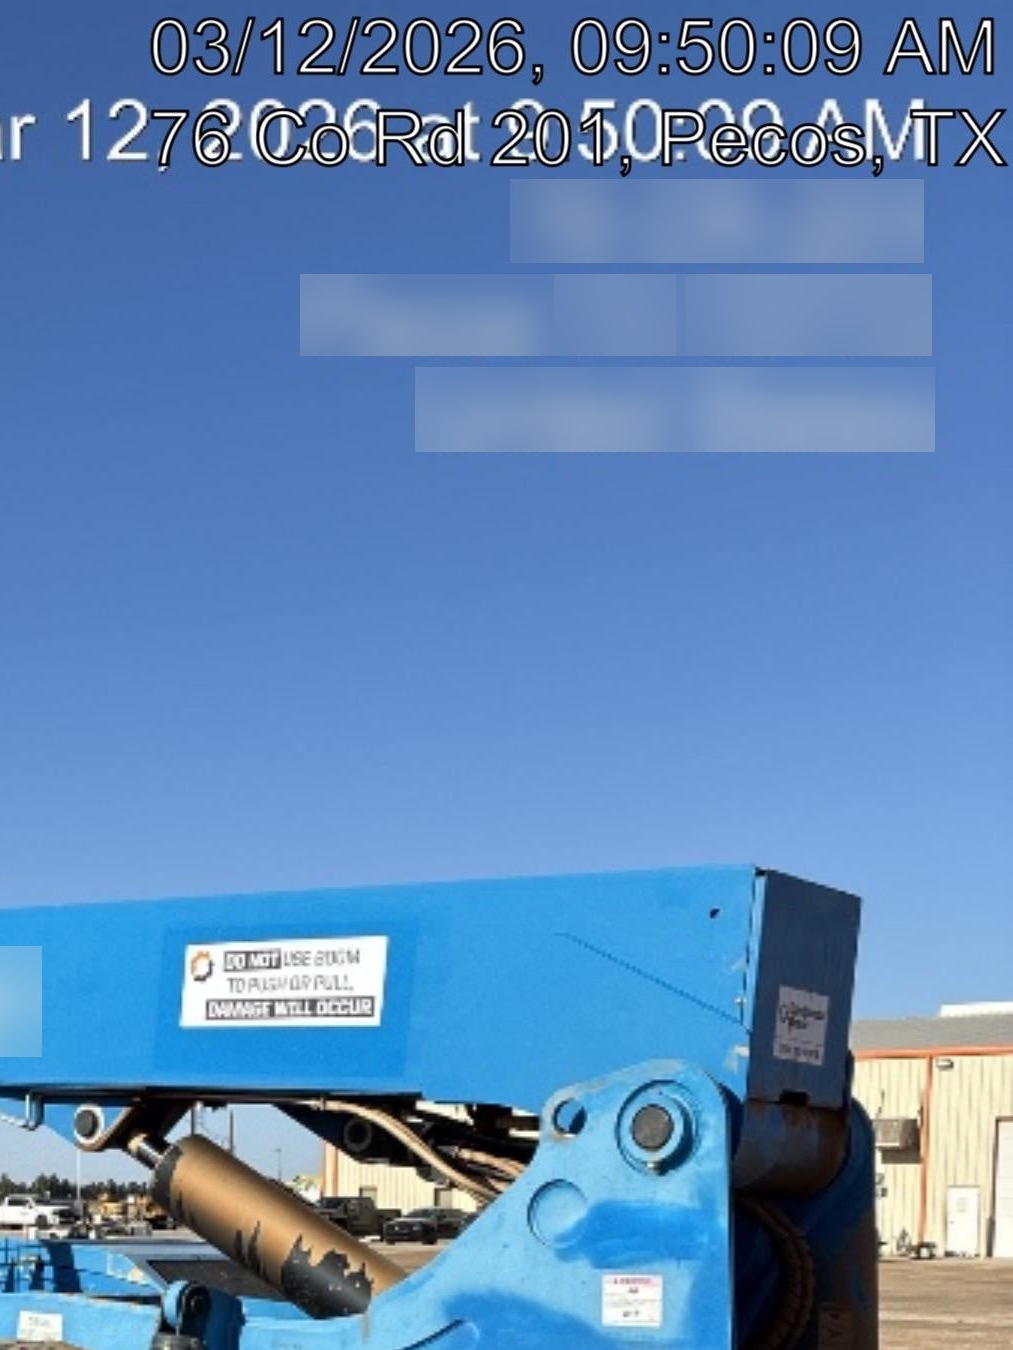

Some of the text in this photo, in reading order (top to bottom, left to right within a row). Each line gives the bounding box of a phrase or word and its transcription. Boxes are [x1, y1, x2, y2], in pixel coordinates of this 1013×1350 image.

[226, 952, 246, 969] DO
[250, 952, 279, 968] NOT
[284, 950, 311, 967] USE
[227, 977, 246, 993] TO
[208, 998, 373, 1019] DAMAGE WILL OCCUR
